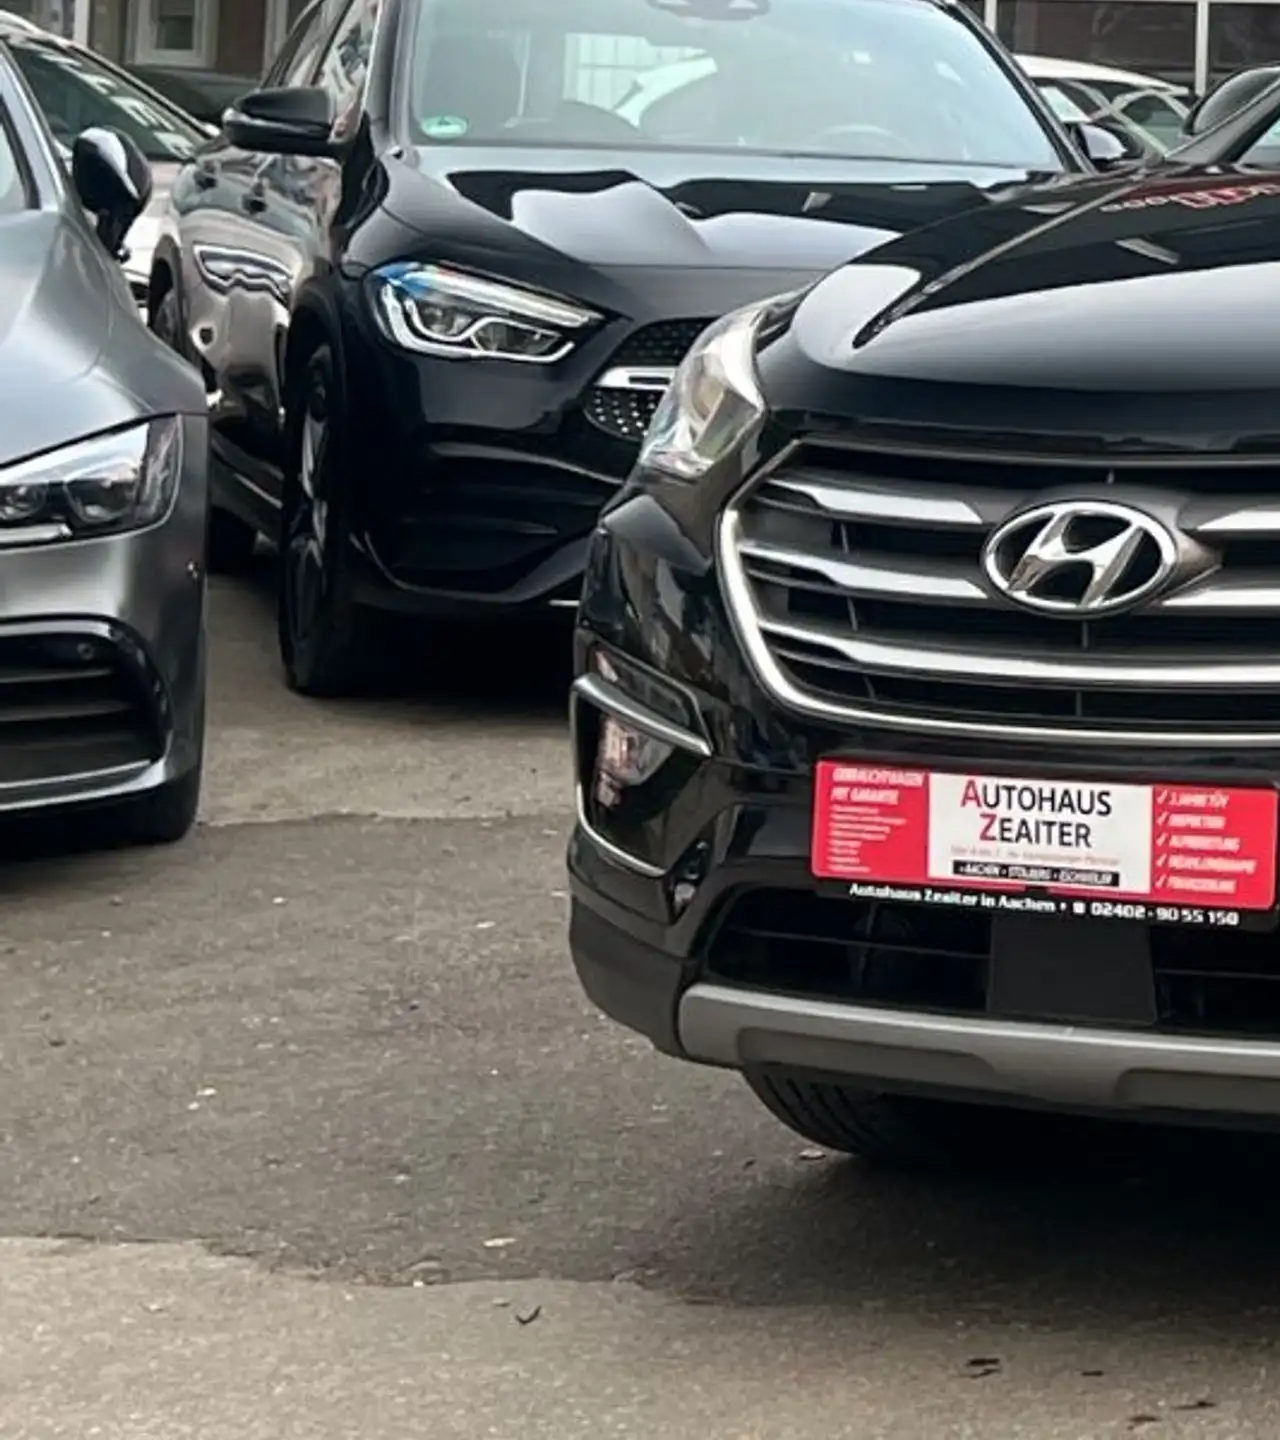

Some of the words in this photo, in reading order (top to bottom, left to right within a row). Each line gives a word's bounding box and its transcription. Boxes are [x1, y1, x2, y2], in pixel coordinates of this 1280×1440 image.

[960, 779, 1113, 817] AUTOHAUS
[979, 813, 1093, 849] ZEAITER
[998, 895, 1056, 912] Aachen
[1091, 902, 1146, 920] 02402
